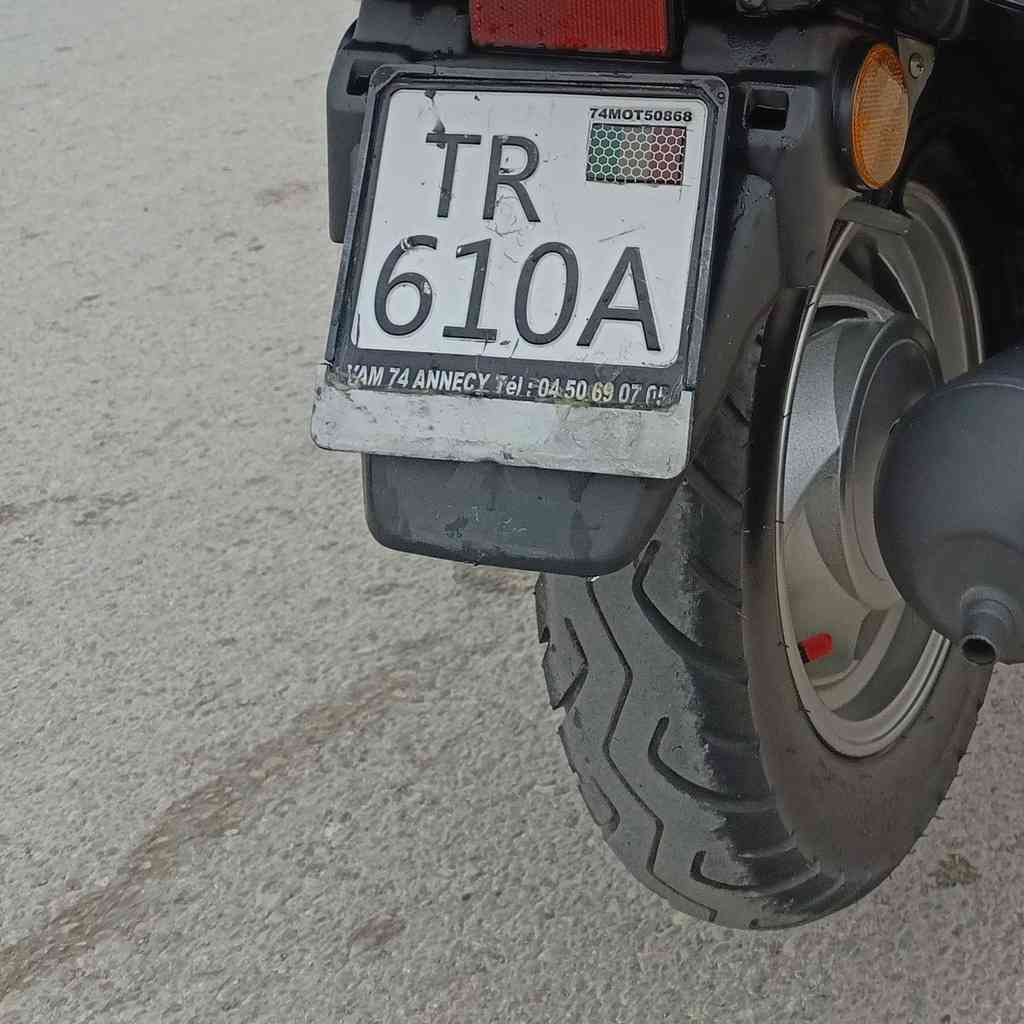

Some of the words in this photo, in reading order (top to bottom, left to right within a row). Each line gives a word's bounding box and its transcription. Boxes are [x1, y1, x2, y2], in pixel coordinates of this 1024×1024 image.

[589, 107, 693, 122] 74MOT50868
[426, 131, 541, 223] TR
[373, 234, 661, 352] 610A
[389, 367, 410, 387] 74
[411, 369, 490, 392] ANNECY
[538, 377, 560, 398] 04
[564, 379, 588, 401] 50
[591, 380, 614, 402] 69
[619, 382, 642, 404] 07
